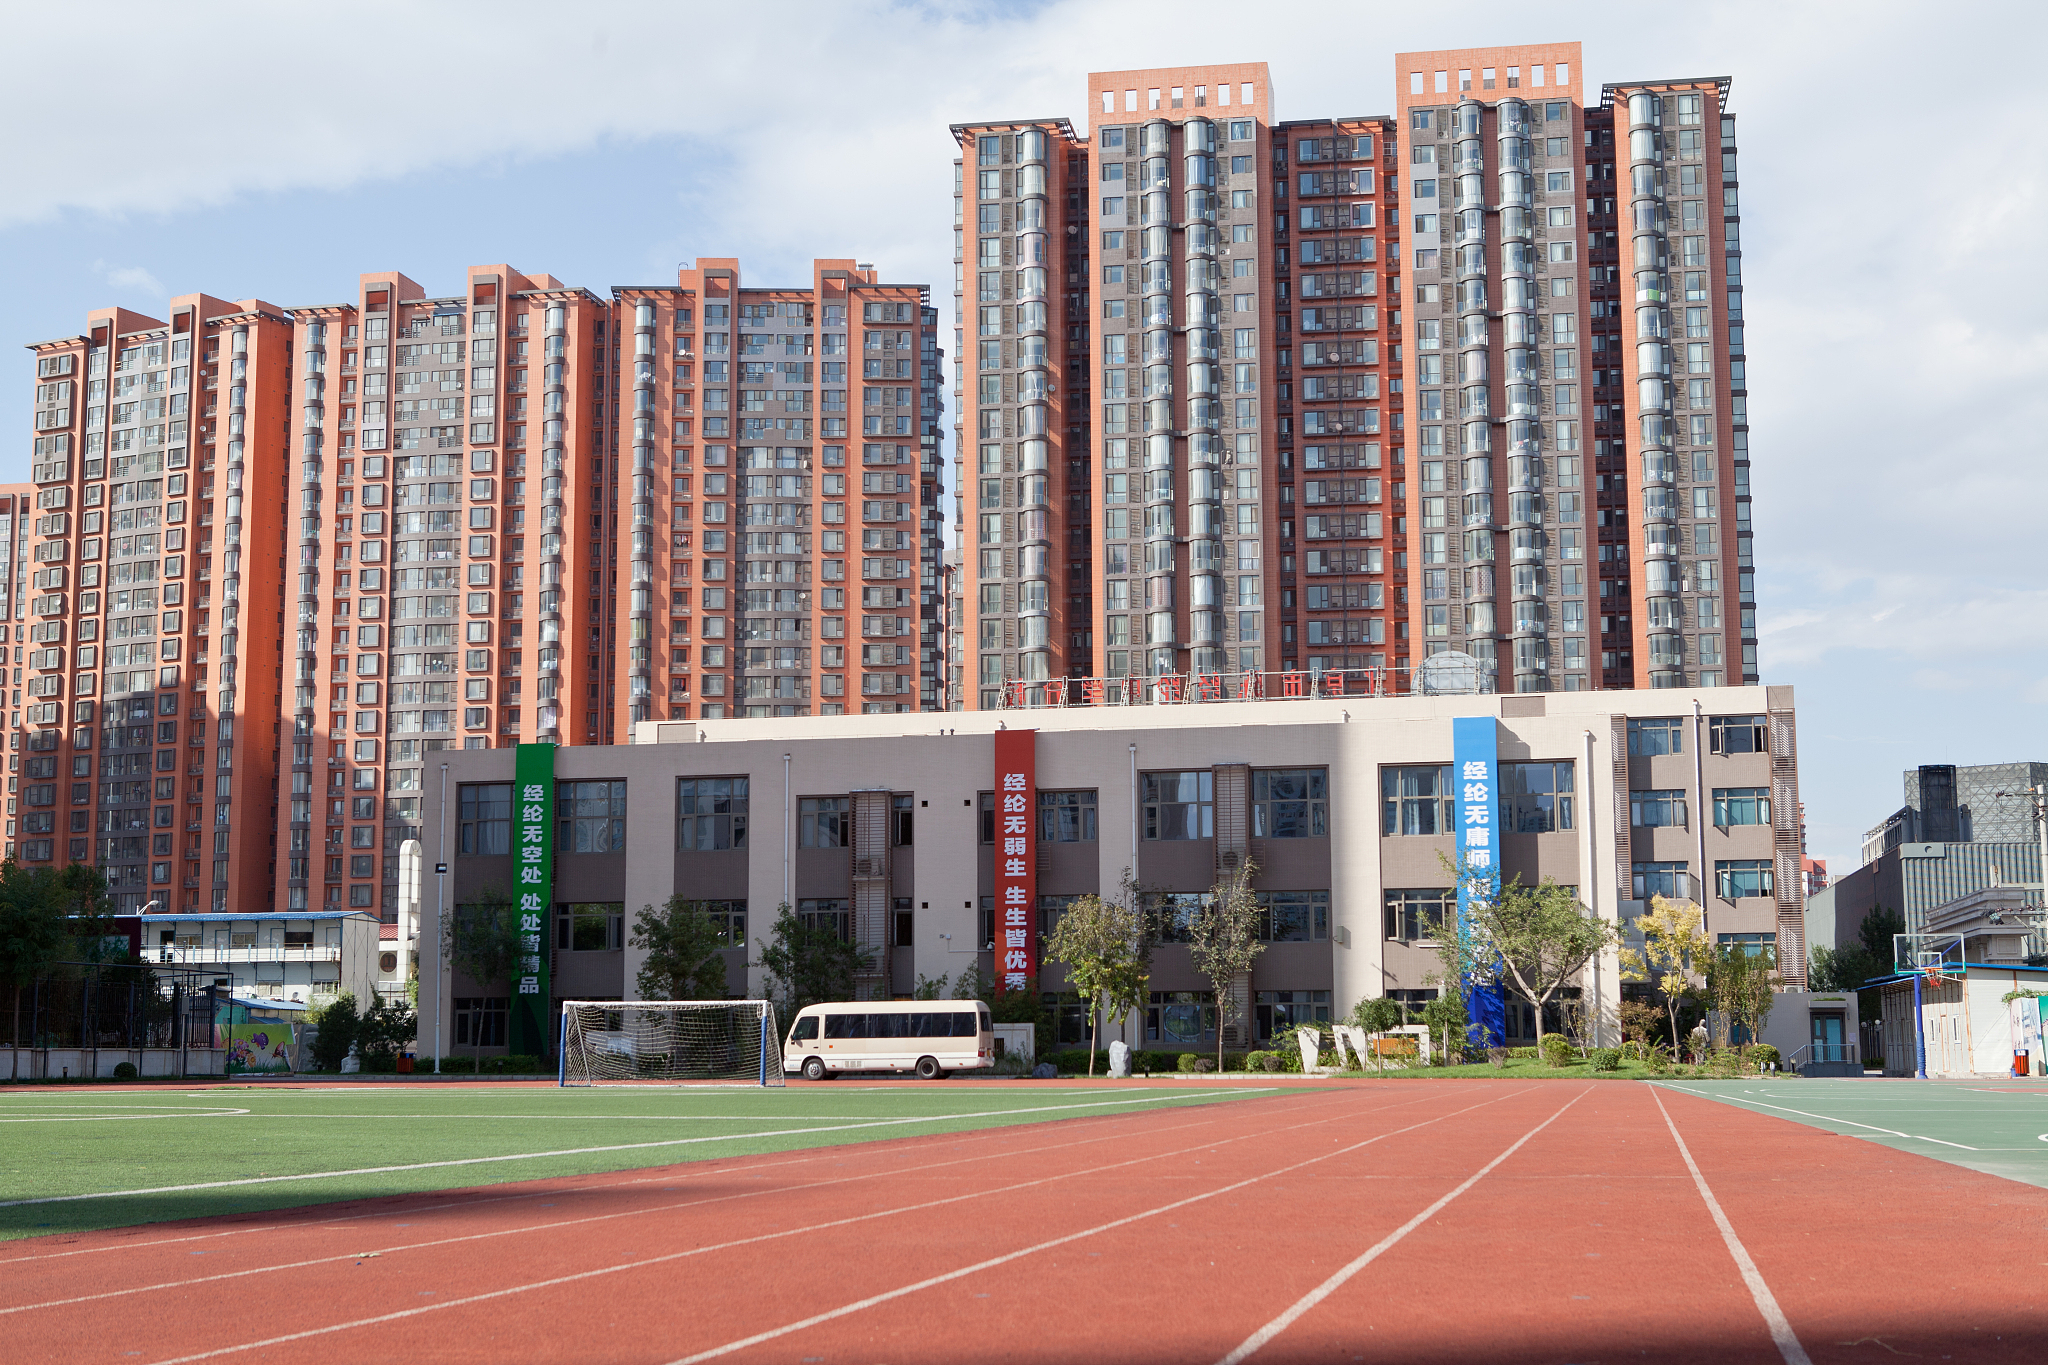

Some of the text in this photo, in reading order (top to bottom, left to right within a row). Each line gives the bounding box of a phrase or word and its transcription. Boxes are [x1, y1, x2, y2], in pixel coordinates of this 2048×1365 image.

[519, 784, 544, 994] 经纶无空处 处处皆精品
[1004, 773, 1027, 991] 经纶无弱生 生生皆优秀
[1463, 761, 1491, 868] 经纶无庸师
